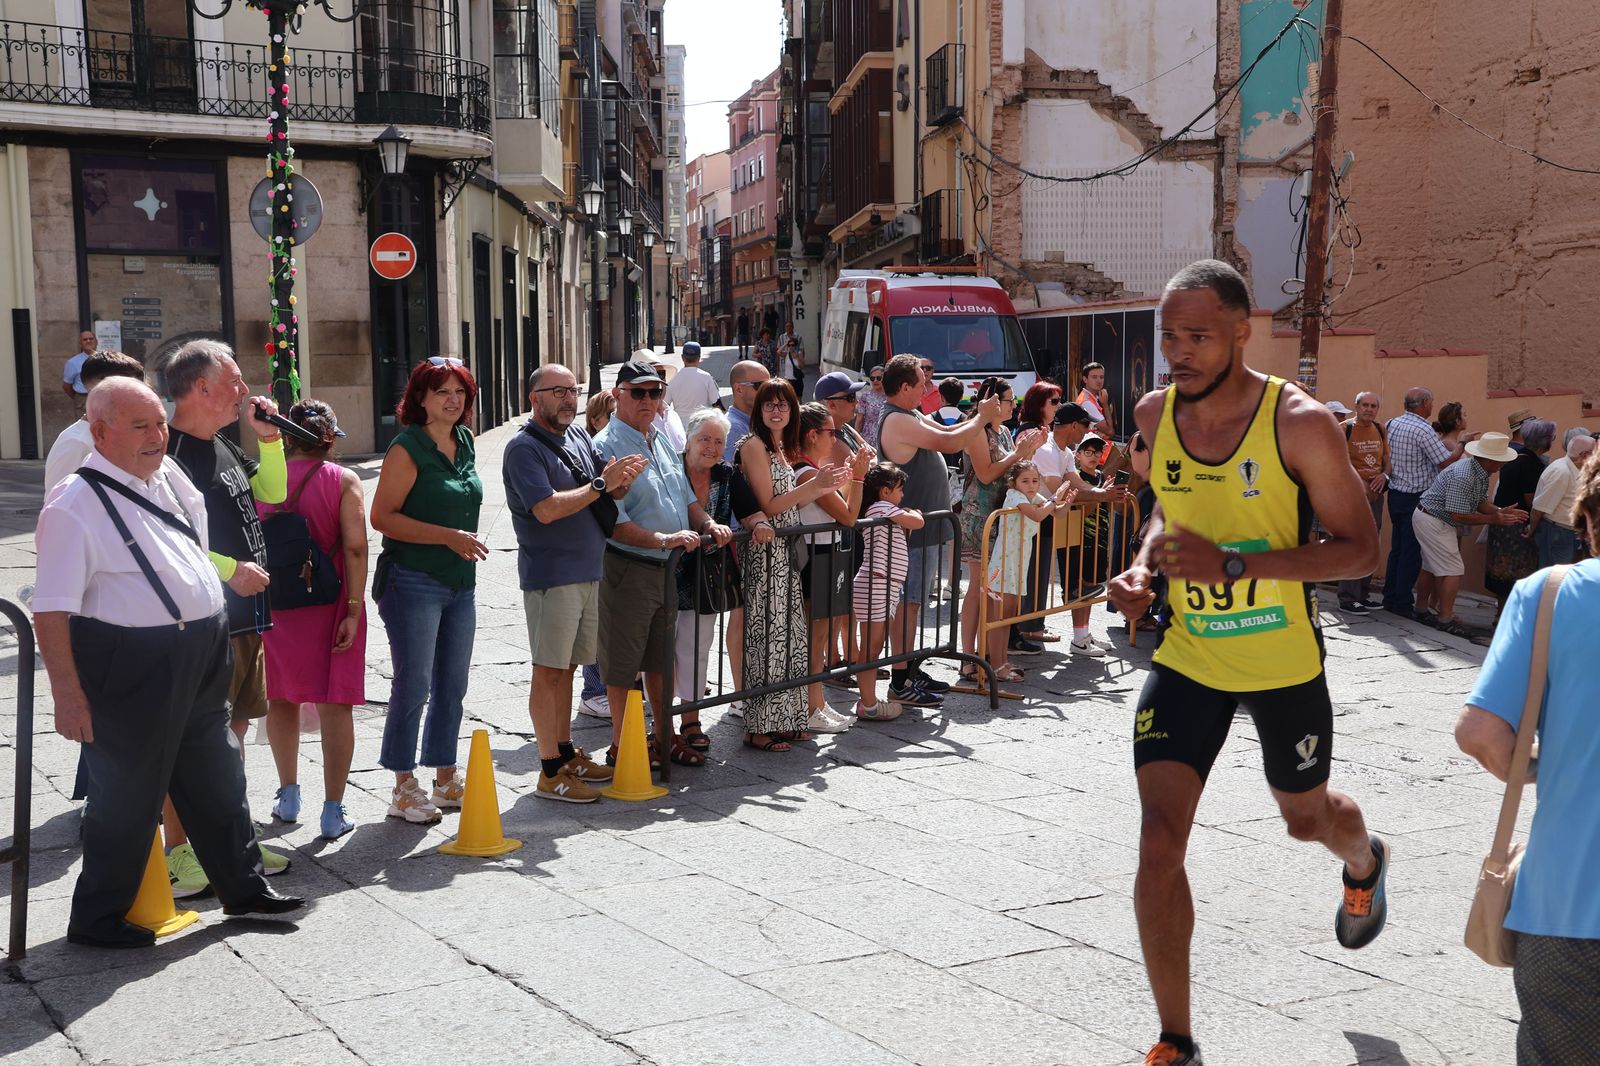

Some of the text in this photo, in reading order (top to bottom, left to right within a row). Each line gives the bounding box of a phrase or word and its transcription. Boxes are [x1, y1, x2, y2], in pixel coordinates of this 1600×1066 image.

[794, 280, 805, 320] BAR
[1209, 612, 1281, 631] CAJA RURAL
[554, 782, 570, 796] N
